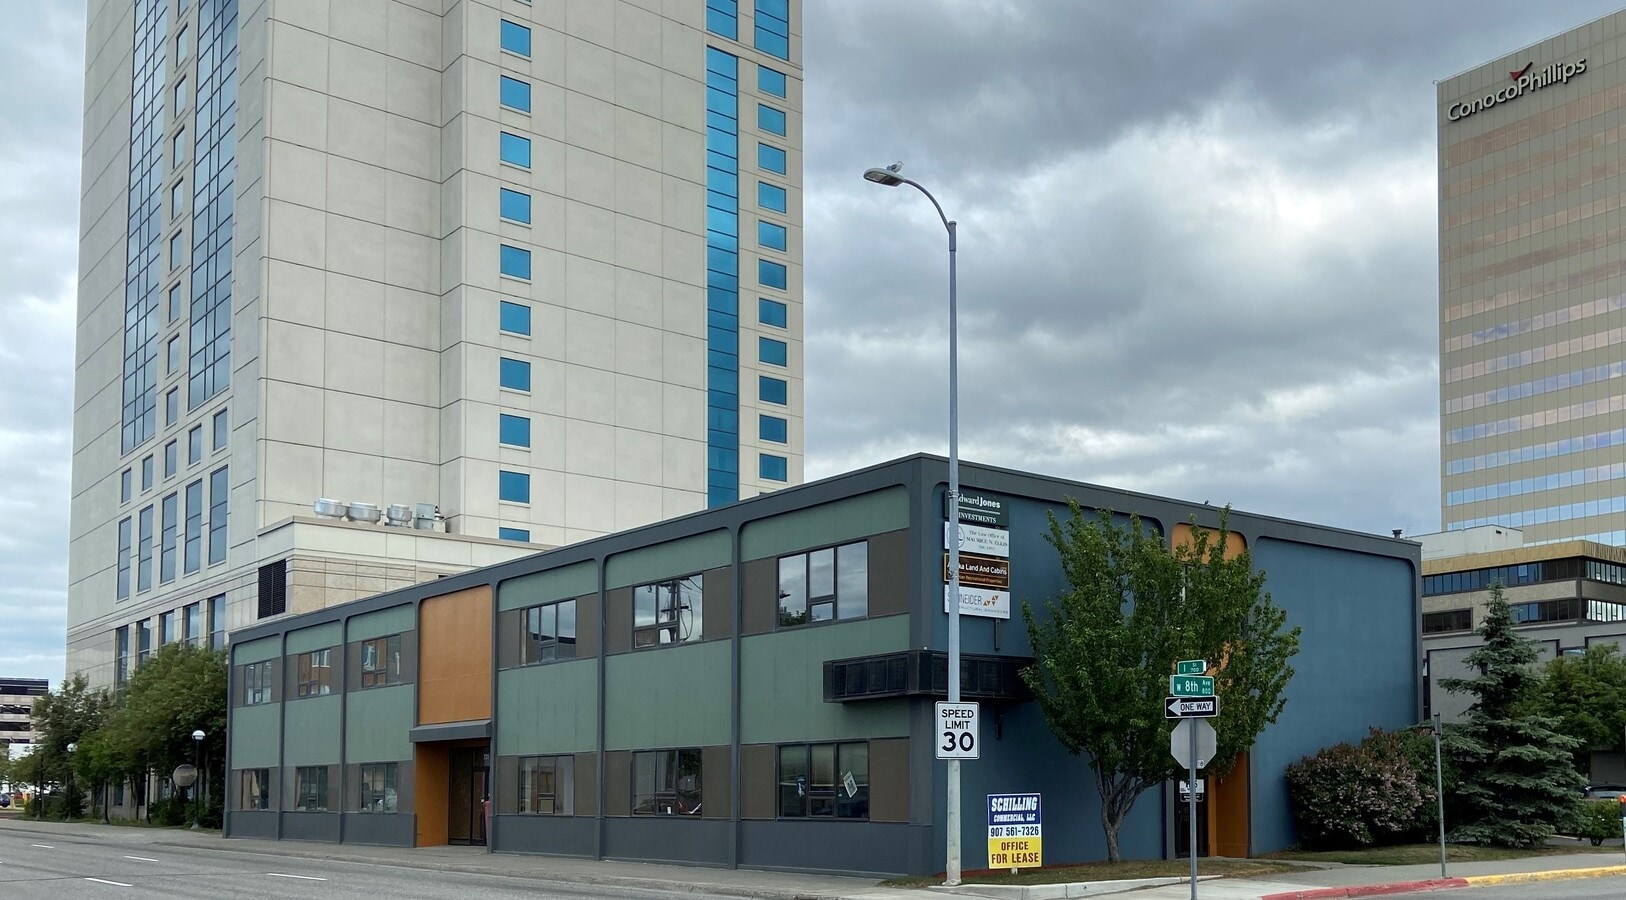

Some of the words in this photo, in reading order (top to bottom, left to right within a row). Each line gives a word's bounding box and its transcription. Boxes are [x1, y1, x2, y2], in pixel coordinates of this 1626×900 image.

[1447, 58, 1586, 121] ConocoPhillips
[958, 493, 1001, 508] dwardJones
[958, 512, 997, 523] INVESTMENTS
[965, 563, 979, 572] Land
[979, 565, 990, 573] And
[990, 566, 1007, 576] Cabins
[1176, 683, 1181, 692] W
[1185, 680, 1198, 692] 8th
[1180, 703, 1194, 711] ONE
[1196, 702, 1211, 710] WAY
[941, 708, 974, 718] SPEED
[945, 720, 970, 730] LIMIT
[942, 731, 974, 752] 30
[991, 797, 1037, 812] SCHILLING
[1026, 813, 1036, 822] LLC
[990, 827, 1003, 837] 907
[1005, 826, 1039, 837] 561-7326
[1001, 841, 1029, 851] OFFICE
[991, 853, 1008, 864] FOR
[1011, 852, 1039, 863] LEASE
